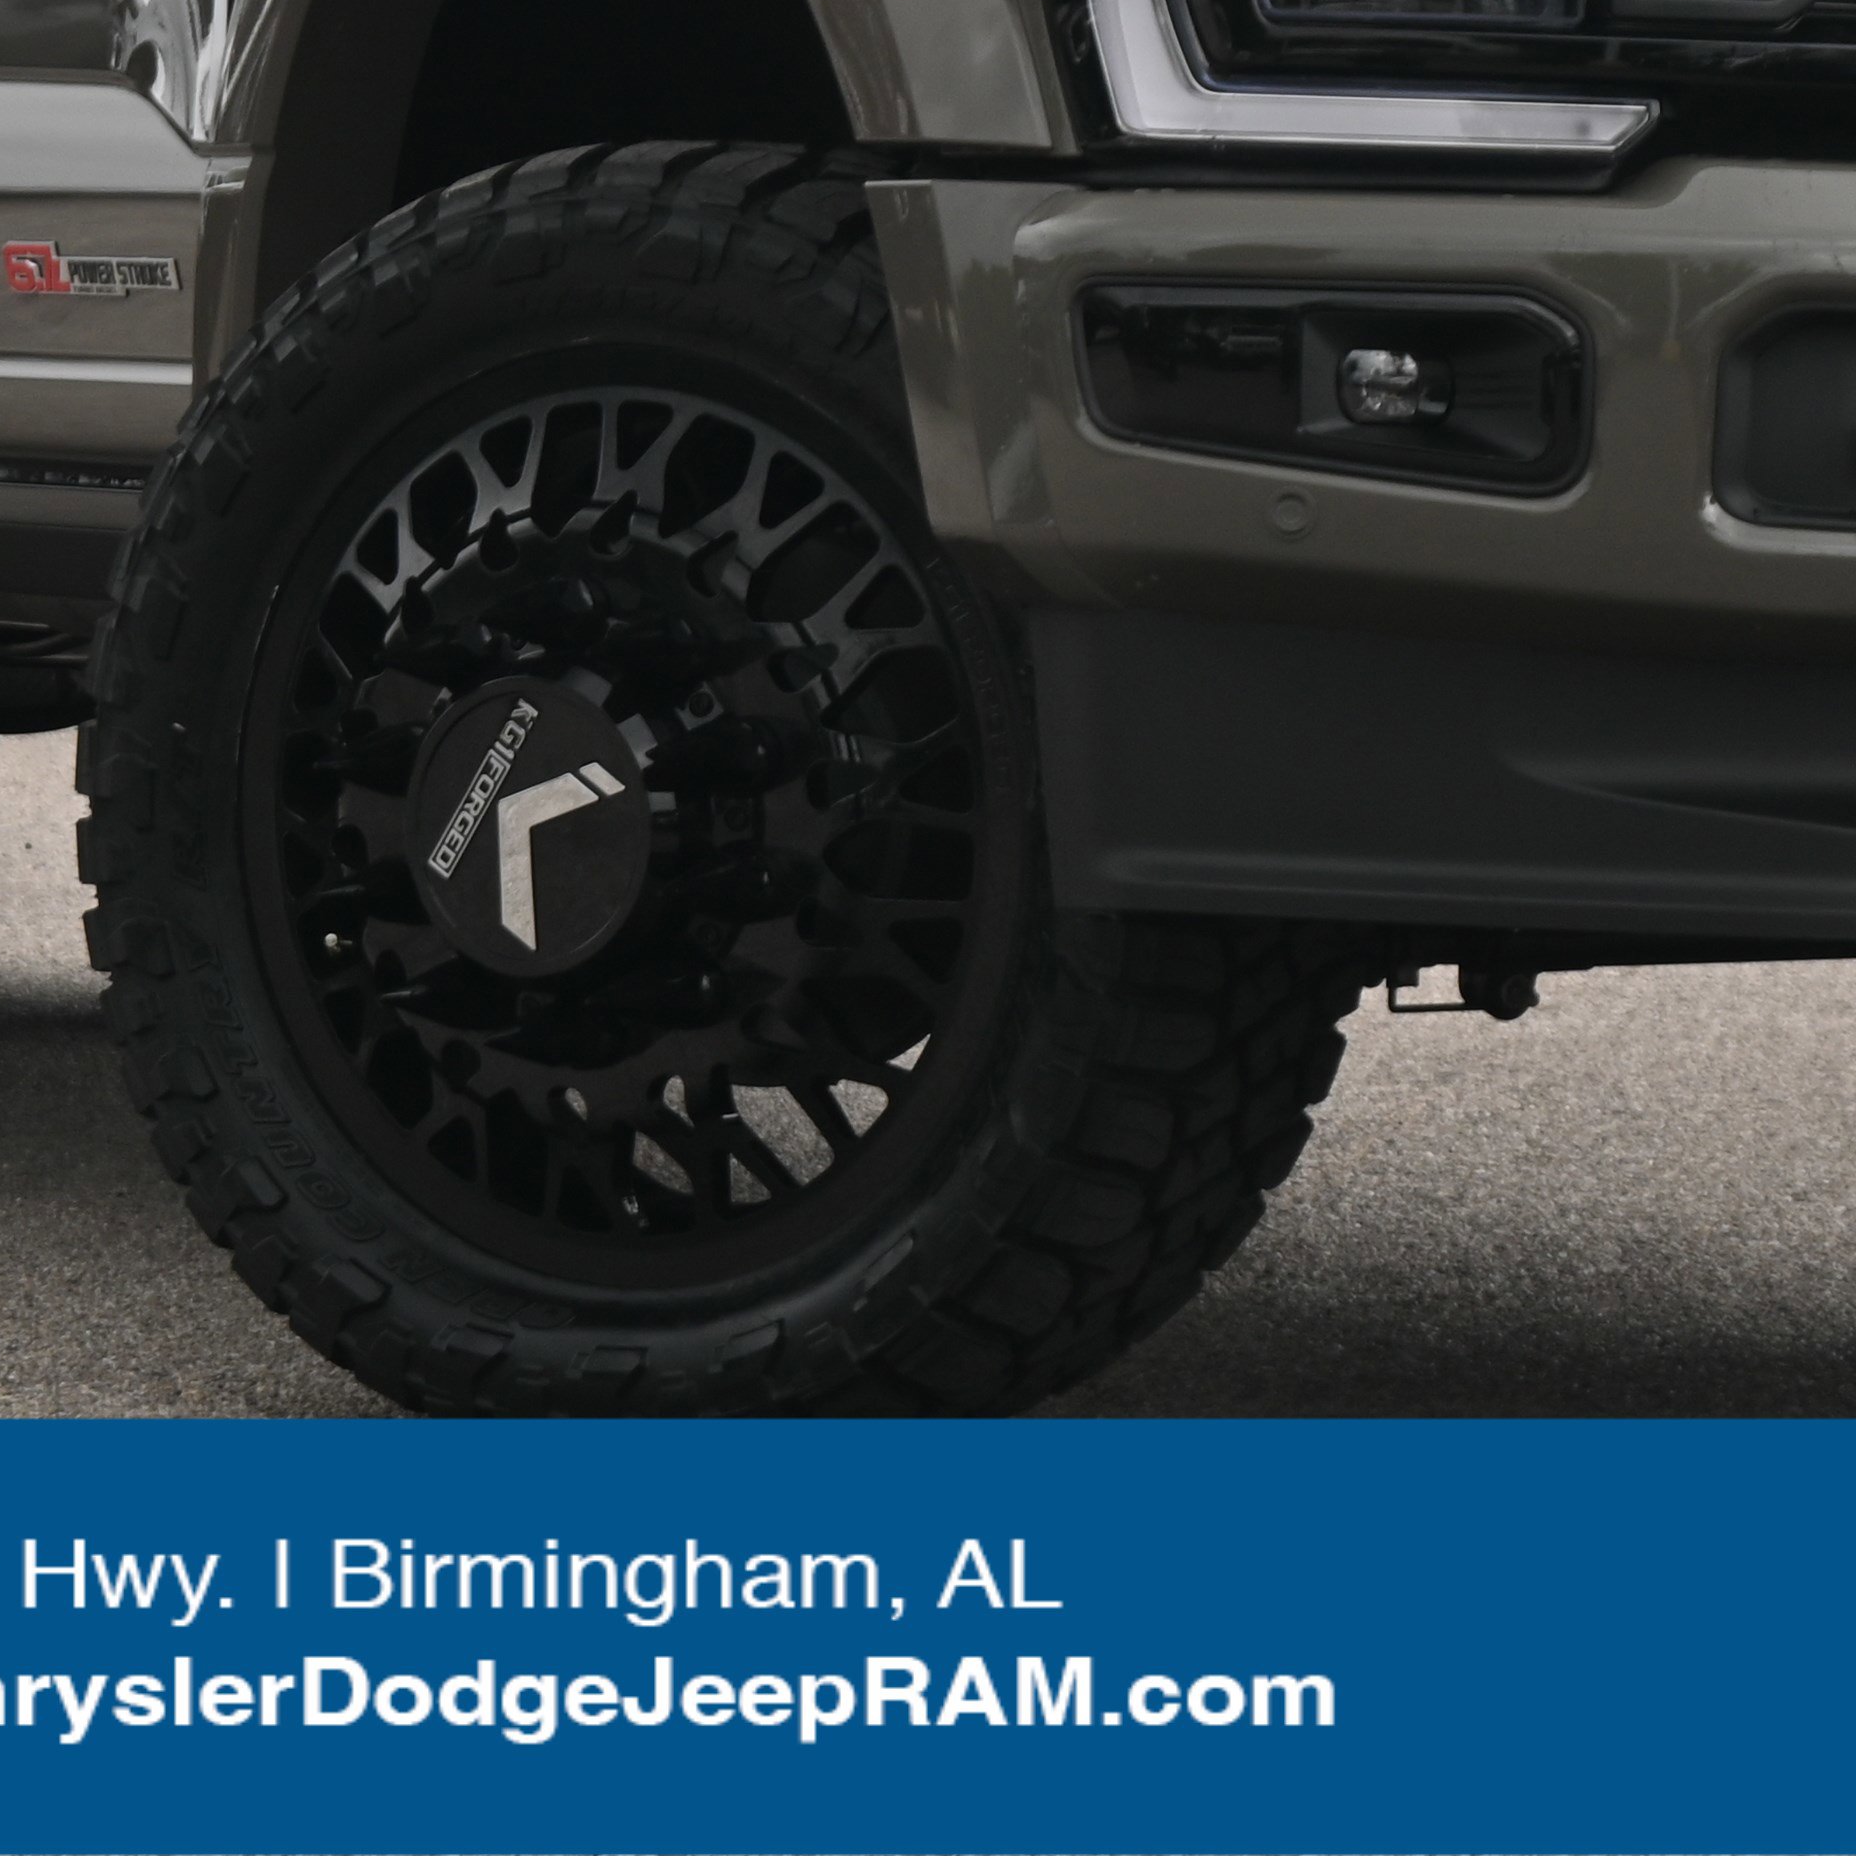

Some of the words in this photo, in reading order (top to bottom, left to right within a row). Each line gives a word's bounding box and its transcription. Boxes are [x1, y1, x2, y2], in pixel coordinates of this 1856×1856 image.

[67, 259, 116, 285] POWER
[115, 260, 173, 288] STROKE
[434, 754, 506, 871] FORGED
